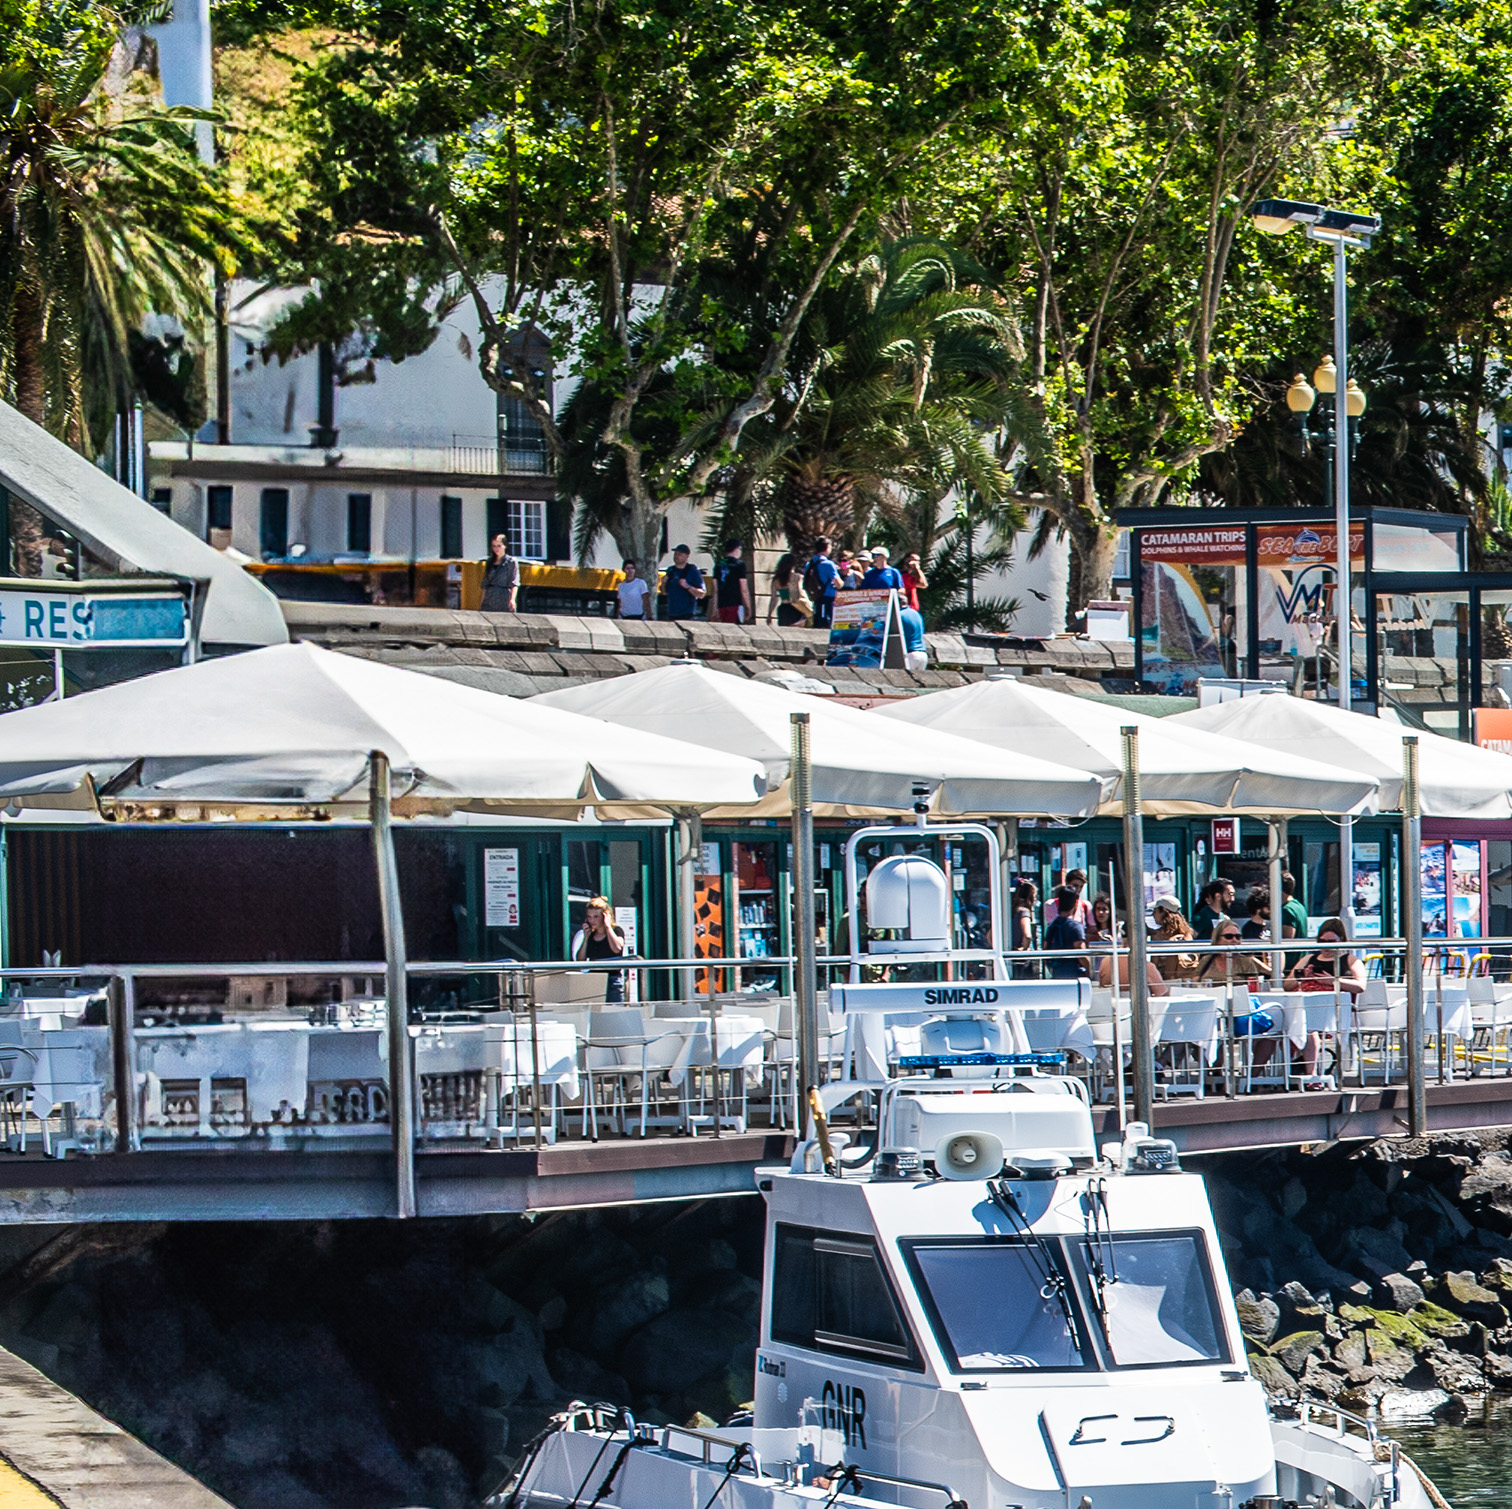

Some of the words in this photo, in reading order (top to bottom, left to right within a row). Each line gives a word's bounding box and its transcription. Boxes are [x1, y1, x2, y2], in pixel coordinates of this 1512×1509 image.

[1141, 531, 1213, 546] CATAMARAN
[1214, 530, 1247, 543] TRIPS
[1257, 537, 1294, 555] SEA
[1319, 534, 1364, 553] BET
[1141, 546, 1177, 555] DOLPHINS
[1178, 546, 1183, 554] &
[1184, 545, 1209, 553] WHALE
[1210, 544, 1247, 553] WATCHING
[1216, 827, 1232, 838] HH
[924, 988, 999, 1005] SIMRAD
[821, 1379, 867, 1450] GNR
